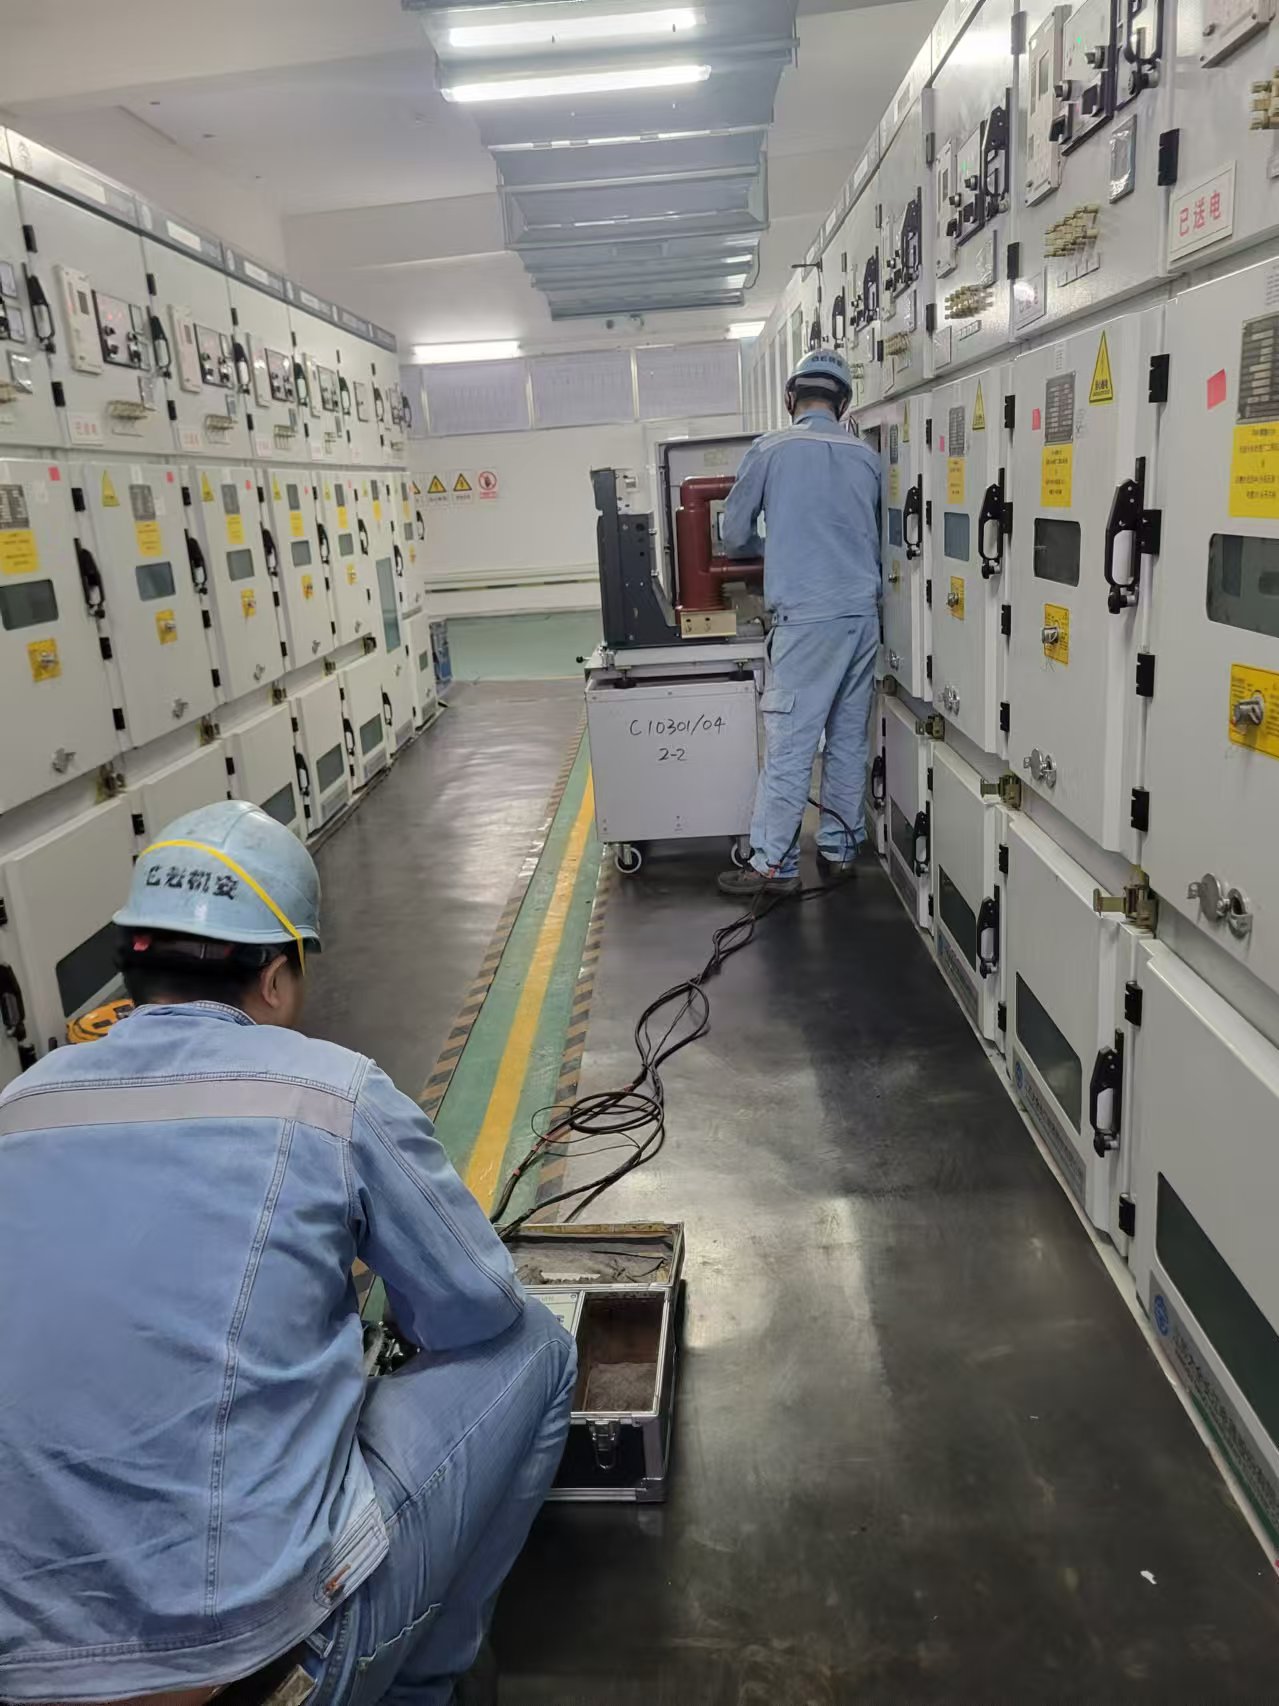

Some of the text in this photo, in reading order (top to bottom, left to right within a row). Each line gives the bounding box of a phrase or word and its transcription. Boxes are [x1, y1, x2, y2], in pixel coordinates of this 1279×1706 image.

[1178, 191, 1221, 237] 已送电
[658, 747, 688, 761] 2-2
